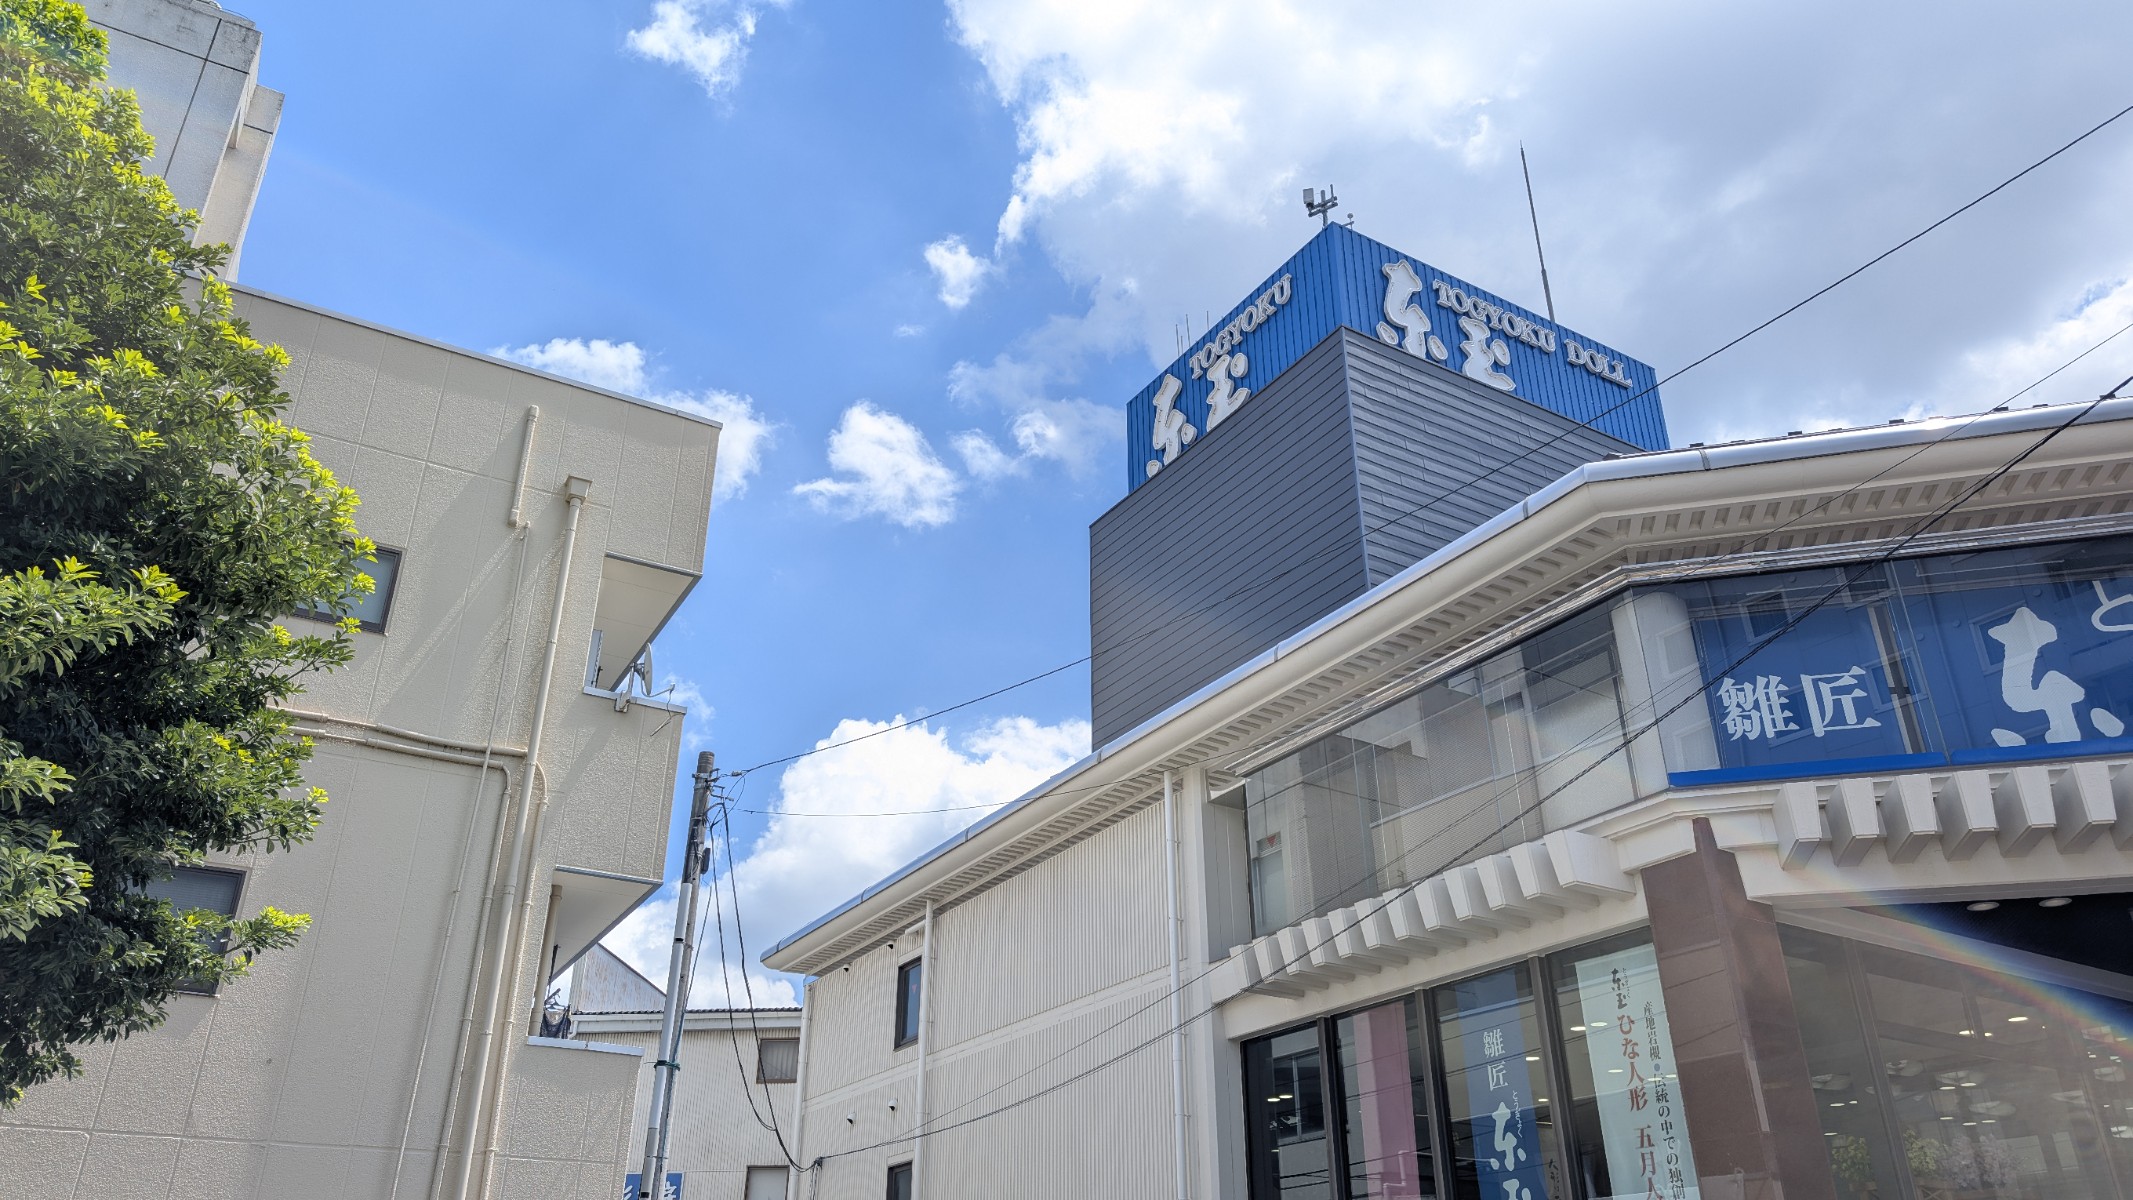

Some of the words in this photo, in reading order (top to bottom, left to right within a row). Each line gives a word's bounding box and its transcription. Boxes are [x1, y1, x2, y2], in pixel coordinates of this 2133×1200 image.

[1189, 272, 1293, 380] TOGYOKU
[1432, 278, 1556, 354] TOGYOKU
[1563, 338, 1633, 388] DOLL
[1716, 665, 1882, 741] 雛匠
[1483, 1028, 1509, 1091] 雛匠
[1616, 1014, 1650, 1112] ひな人形
